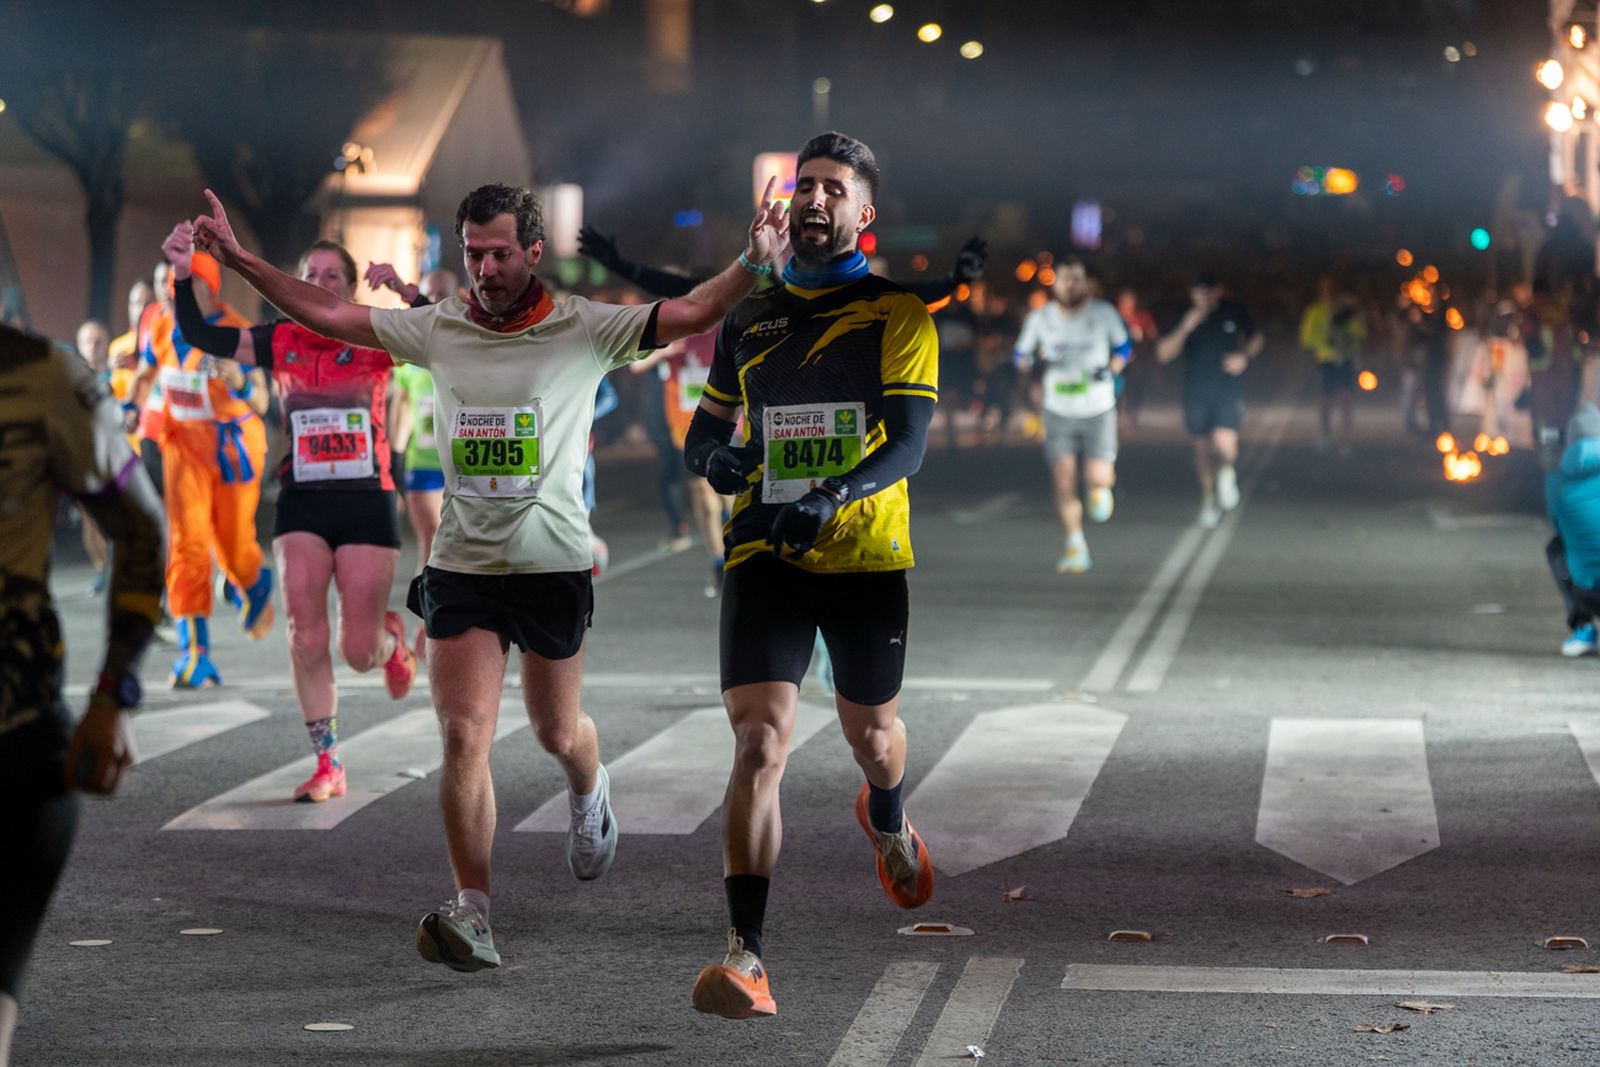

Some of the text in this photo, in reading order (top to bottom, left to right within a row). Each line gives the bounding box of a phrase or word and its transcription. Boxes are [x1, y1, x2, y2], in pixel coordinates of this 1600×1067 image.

[467, 417, 506, 426] NOCHE DE
[784, 415, 811, 426] NOCHE
[812, 414, 825, 424] DE
[459, 426, 506, 438] SAN ANTÓN
[774, 428, 793, 439] SAN
[793, 424, 826, 438] ANTÓN
[308, 432, 356, 456] 9433
[465, 440, 523, 466] 3795
[783, 438, 845, 469] 8474
